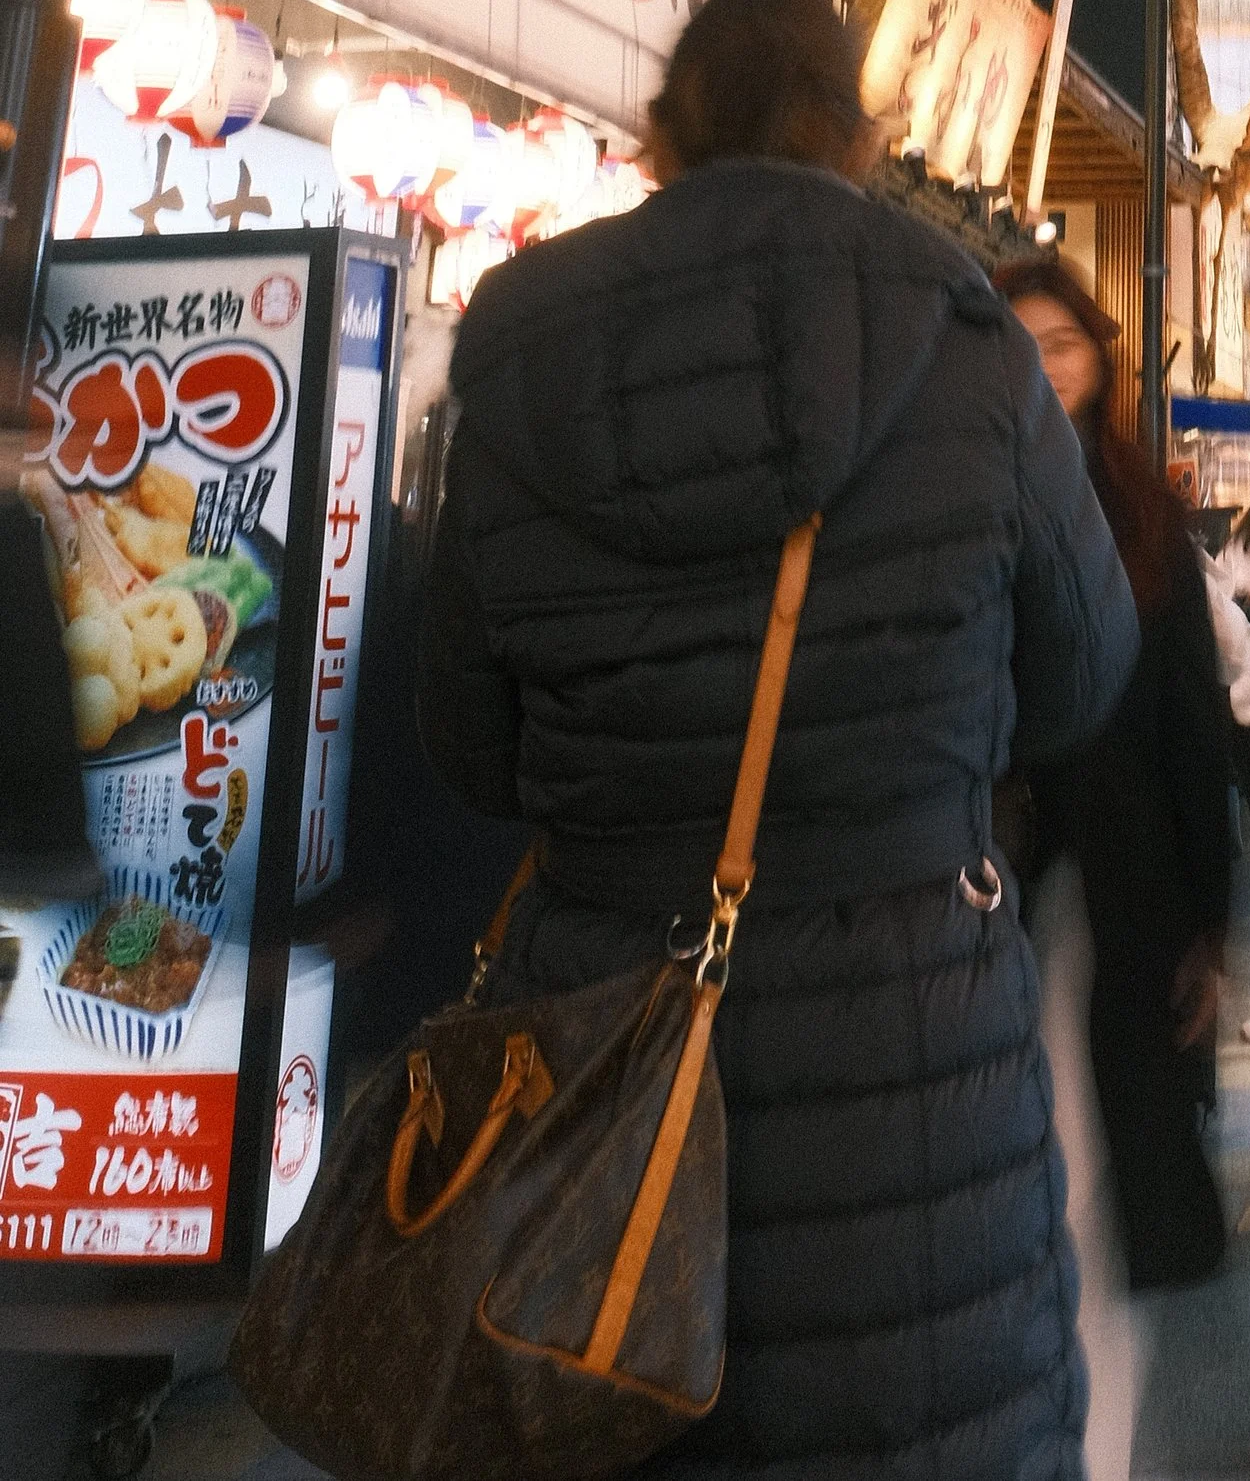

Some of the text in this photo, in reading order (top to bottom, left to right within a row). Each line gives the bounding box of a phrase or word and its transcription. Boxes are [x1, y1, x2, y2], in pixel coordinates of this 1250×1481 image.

[62, 287, 244, 352] 新世界名物
[20, 344, 277, 476] かつ
[297, 420, 365, 888] アサヒビール
[169, 716, 240, 909] どて焼
